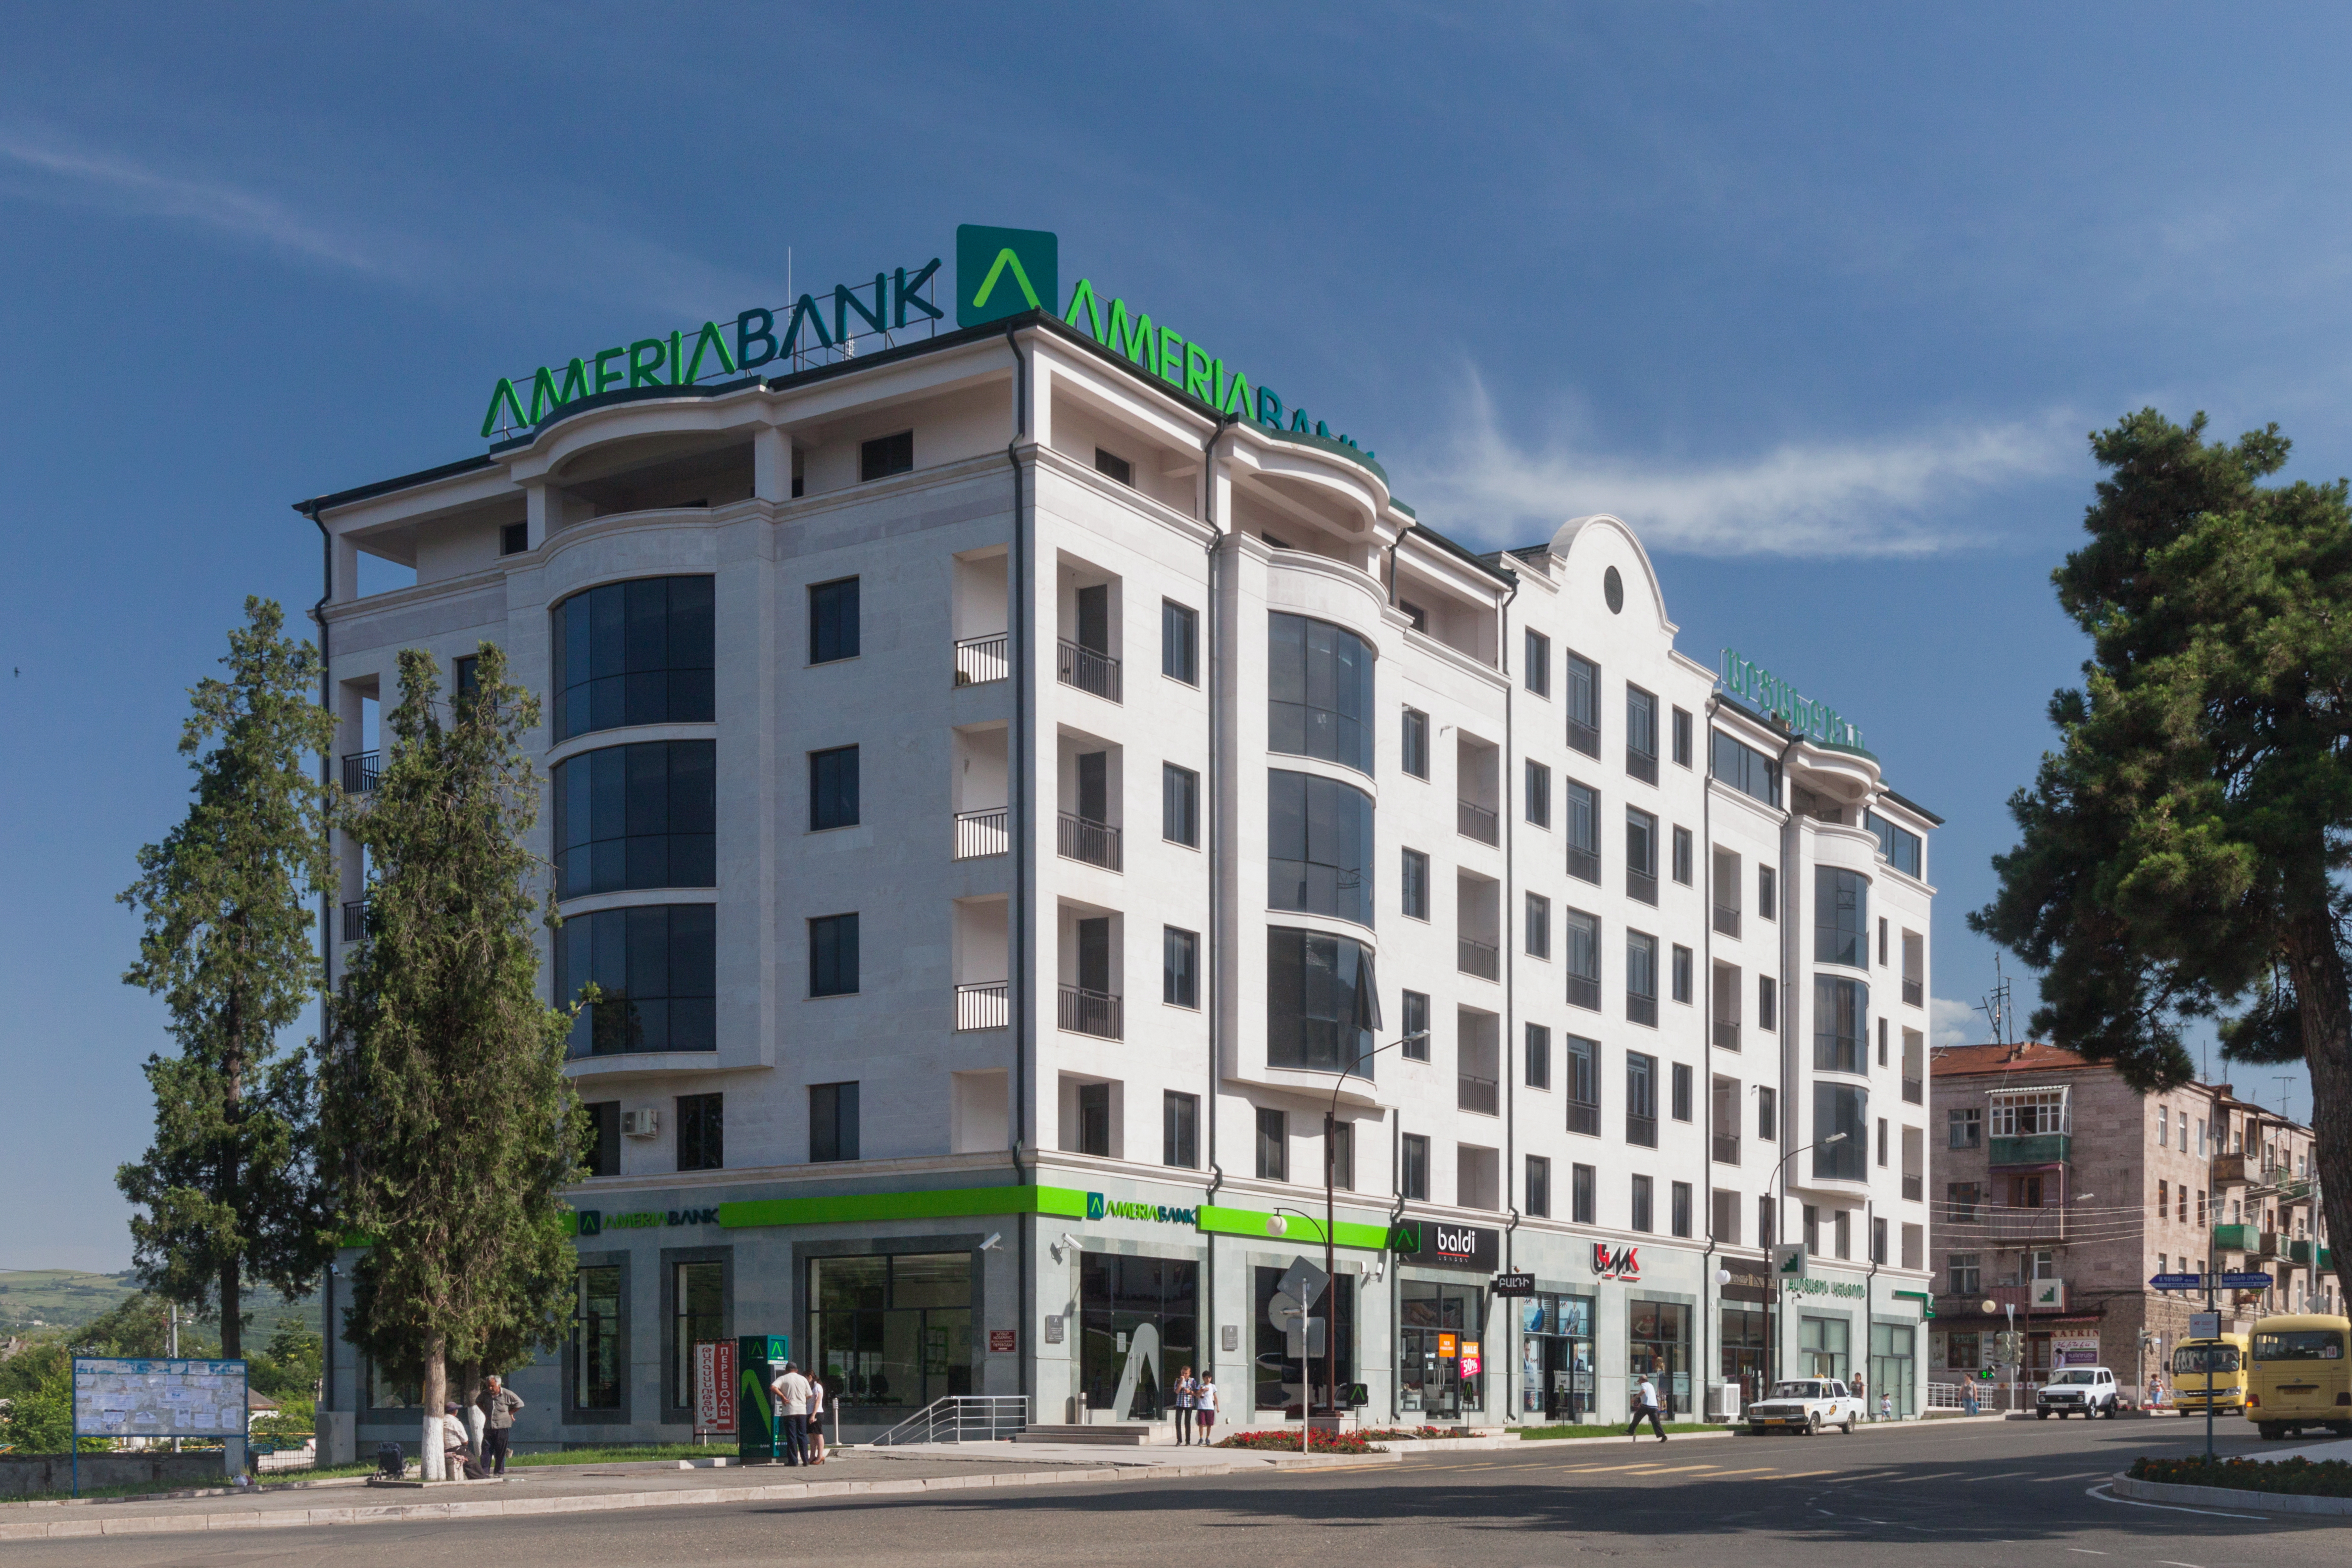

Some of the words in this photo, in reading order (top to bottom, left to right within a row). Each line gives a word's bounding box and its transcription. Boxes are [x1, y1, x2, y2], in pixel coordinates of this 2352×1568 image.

[481, 258, 944, 438] AMERIABANK
[602, 1208, 719, 1230] AMERIABANK
[1105, 1200, 1196, 1225] AMERIABANK
[1438, 1226, 1475, 1253] baldi
[1499, 1277, 1530, 1288] ԲԱԼԴԻ
[1464, 1345, 1477, 1354] SALE
[2328, 1347, 2336, 1356] 14
[1463, 1358, 1478, 1373] 50%
[719, 1347, 731, 1417] ПЕРЕВОДЫ
